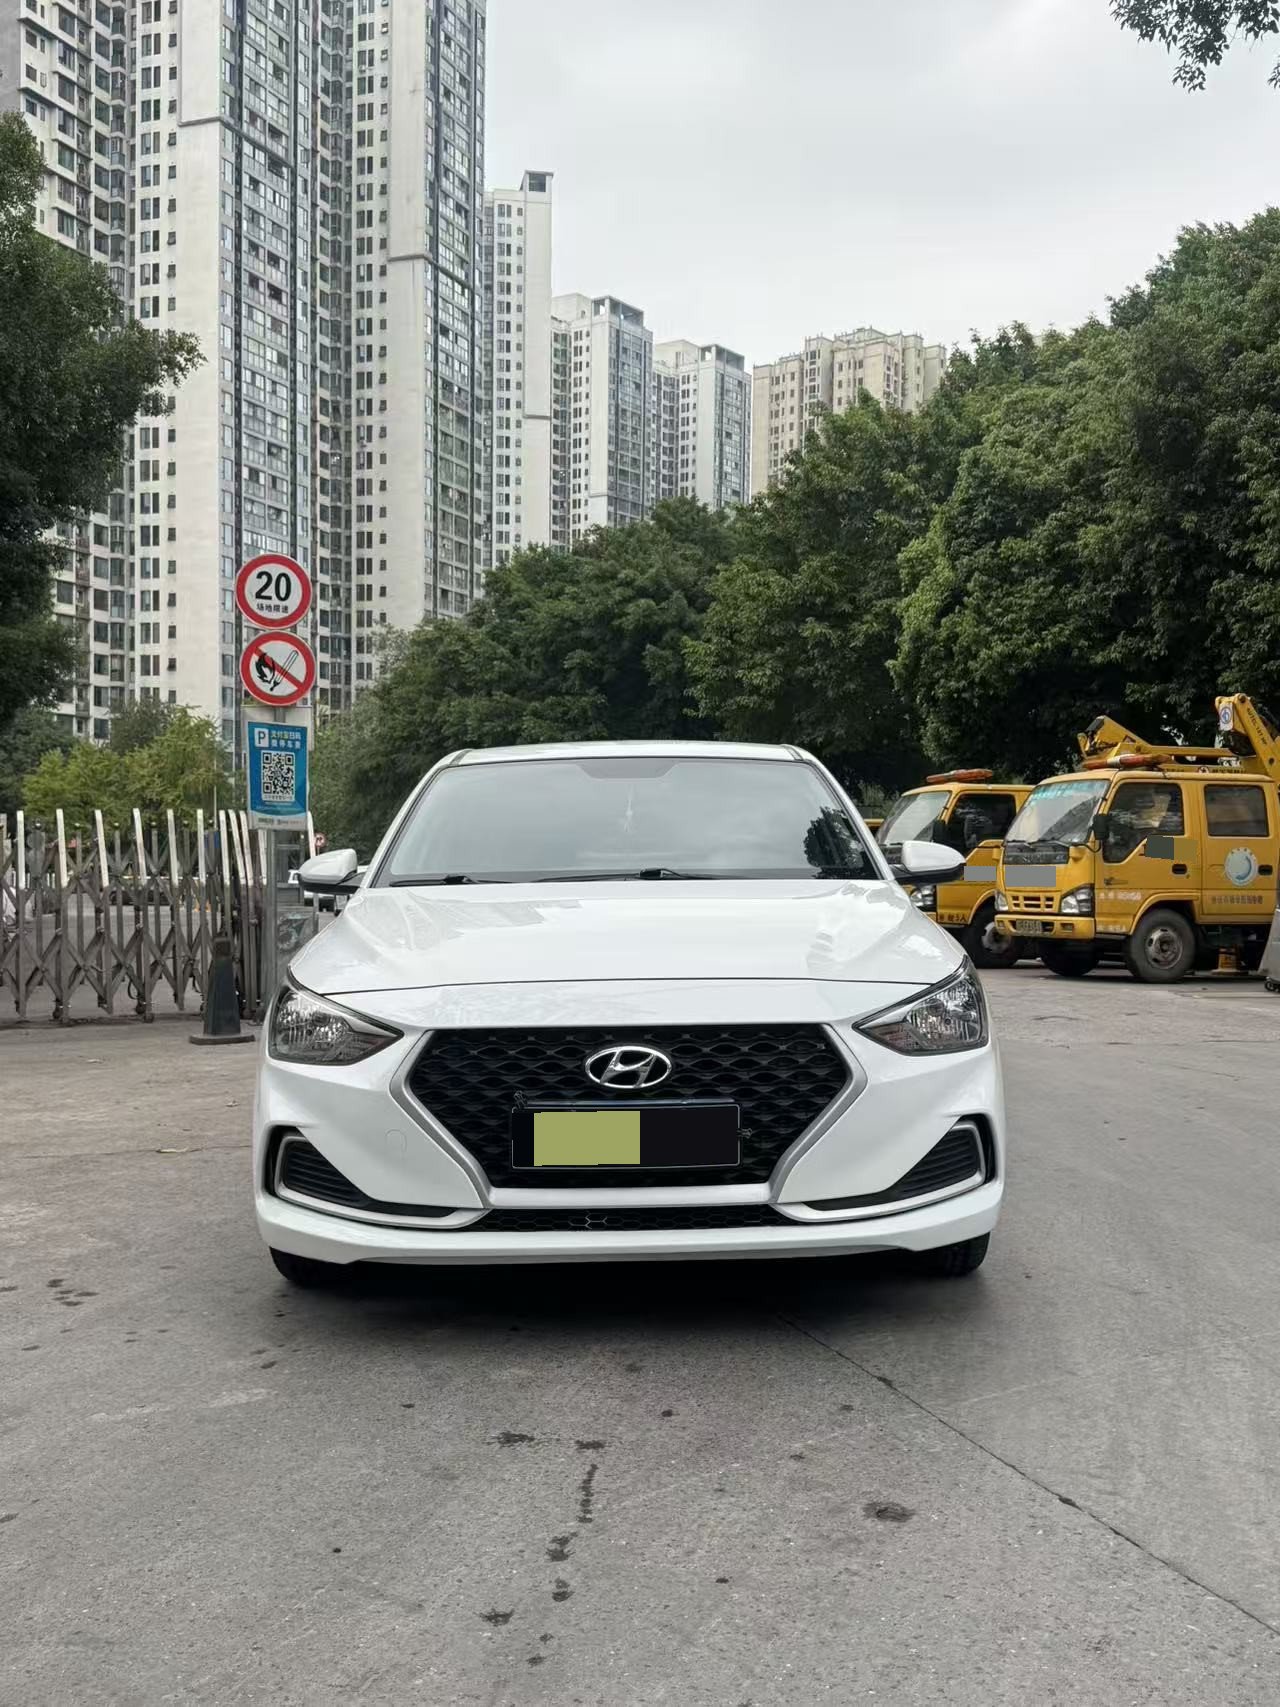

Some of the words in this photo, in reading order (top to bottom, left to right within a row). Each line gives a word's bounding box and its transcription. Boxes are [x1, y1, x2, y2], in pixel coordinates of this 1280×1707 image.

[255, 571, 292, 601] 20
[256, 602, 289, 613] 场地限速
[258, 731, 266, 744] P
